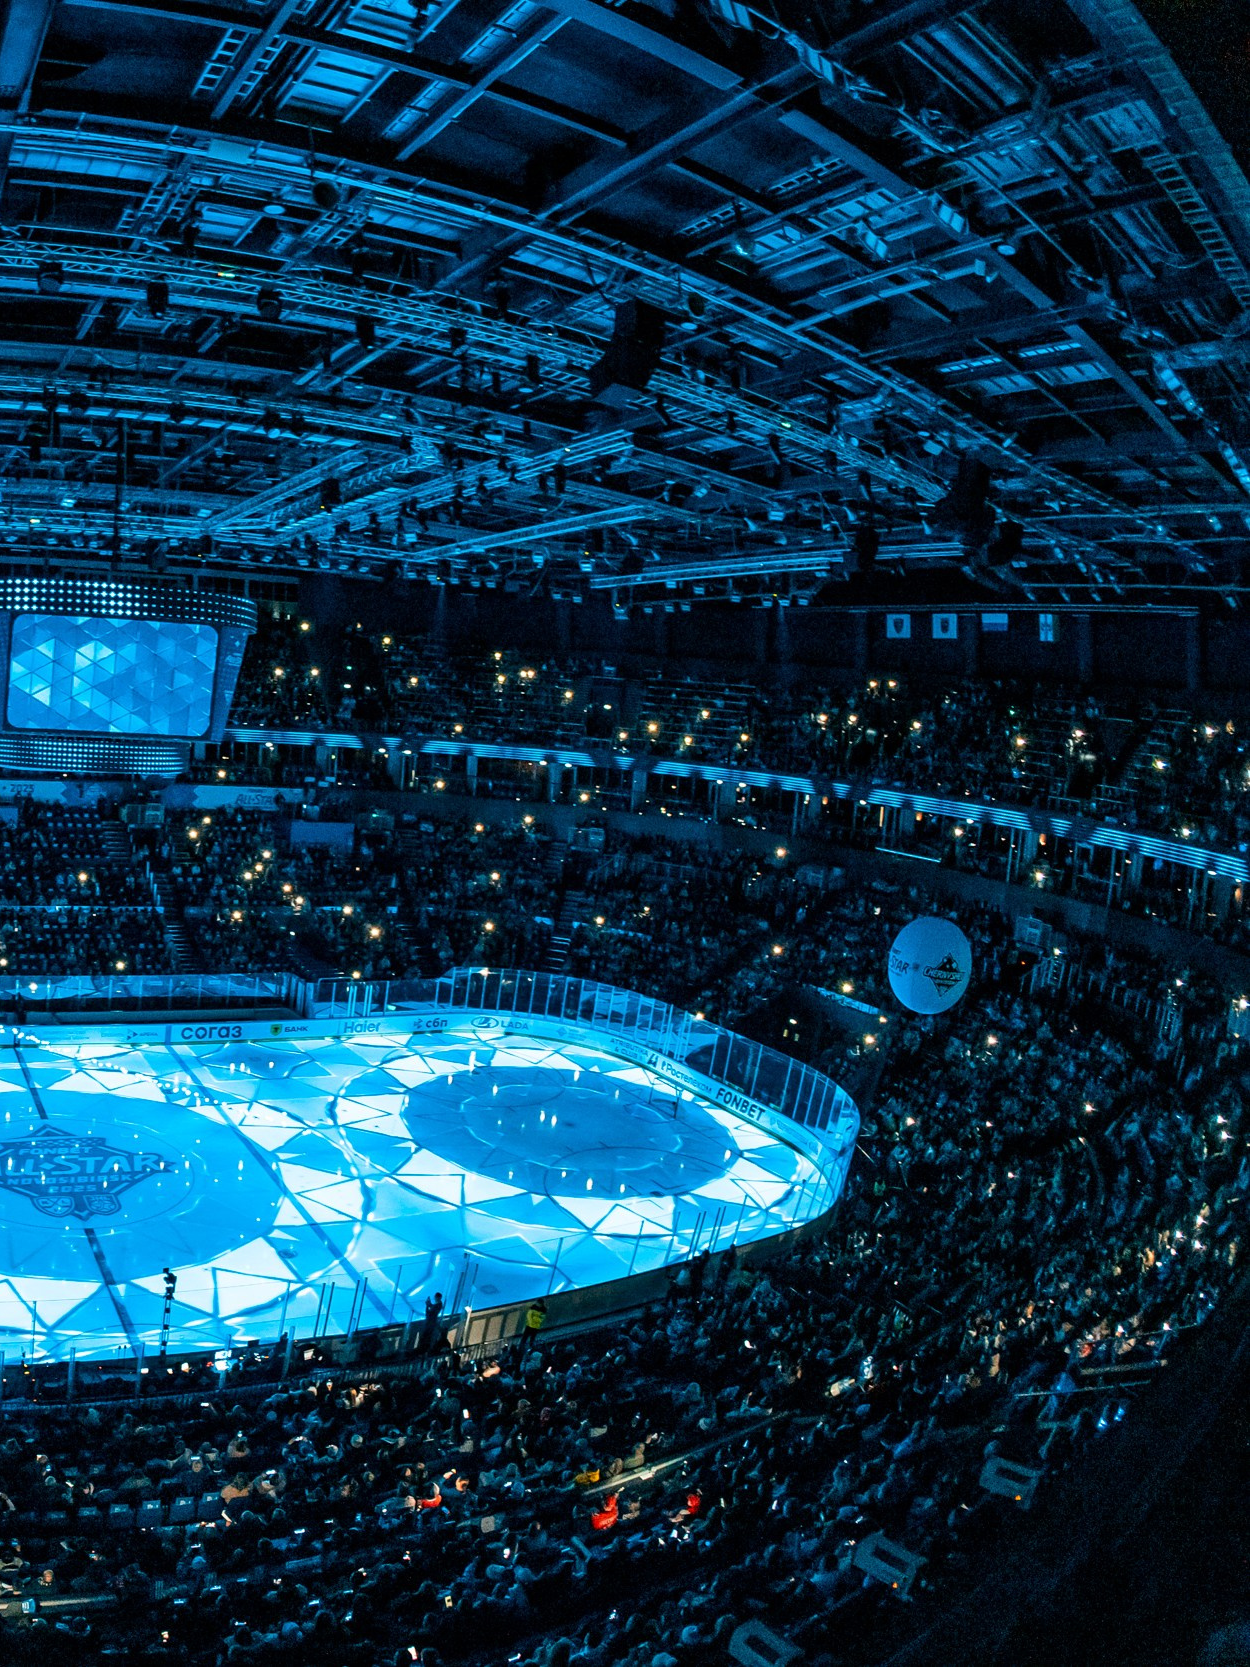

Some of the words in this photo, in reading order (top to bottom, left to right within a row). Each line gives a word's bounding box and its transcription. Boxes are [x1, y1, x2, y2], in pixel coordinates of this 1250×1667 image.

[10, 784, 35, 793] 2025
[284, 1025, 308, 1033] БАНК
[344, 1021, 381, 1034] Haier
[500, 1019, 529, 1030] LADA
[666, 1063, 712, 1093] Ростелеком
[715, 1087, 766, 1121] FONBET
[18, 1146, 95, 1156] FONBET
[6, 1174, 134, 1186] NOVOSIBIRSK
[47, 1184, 97, 1194] 2025
